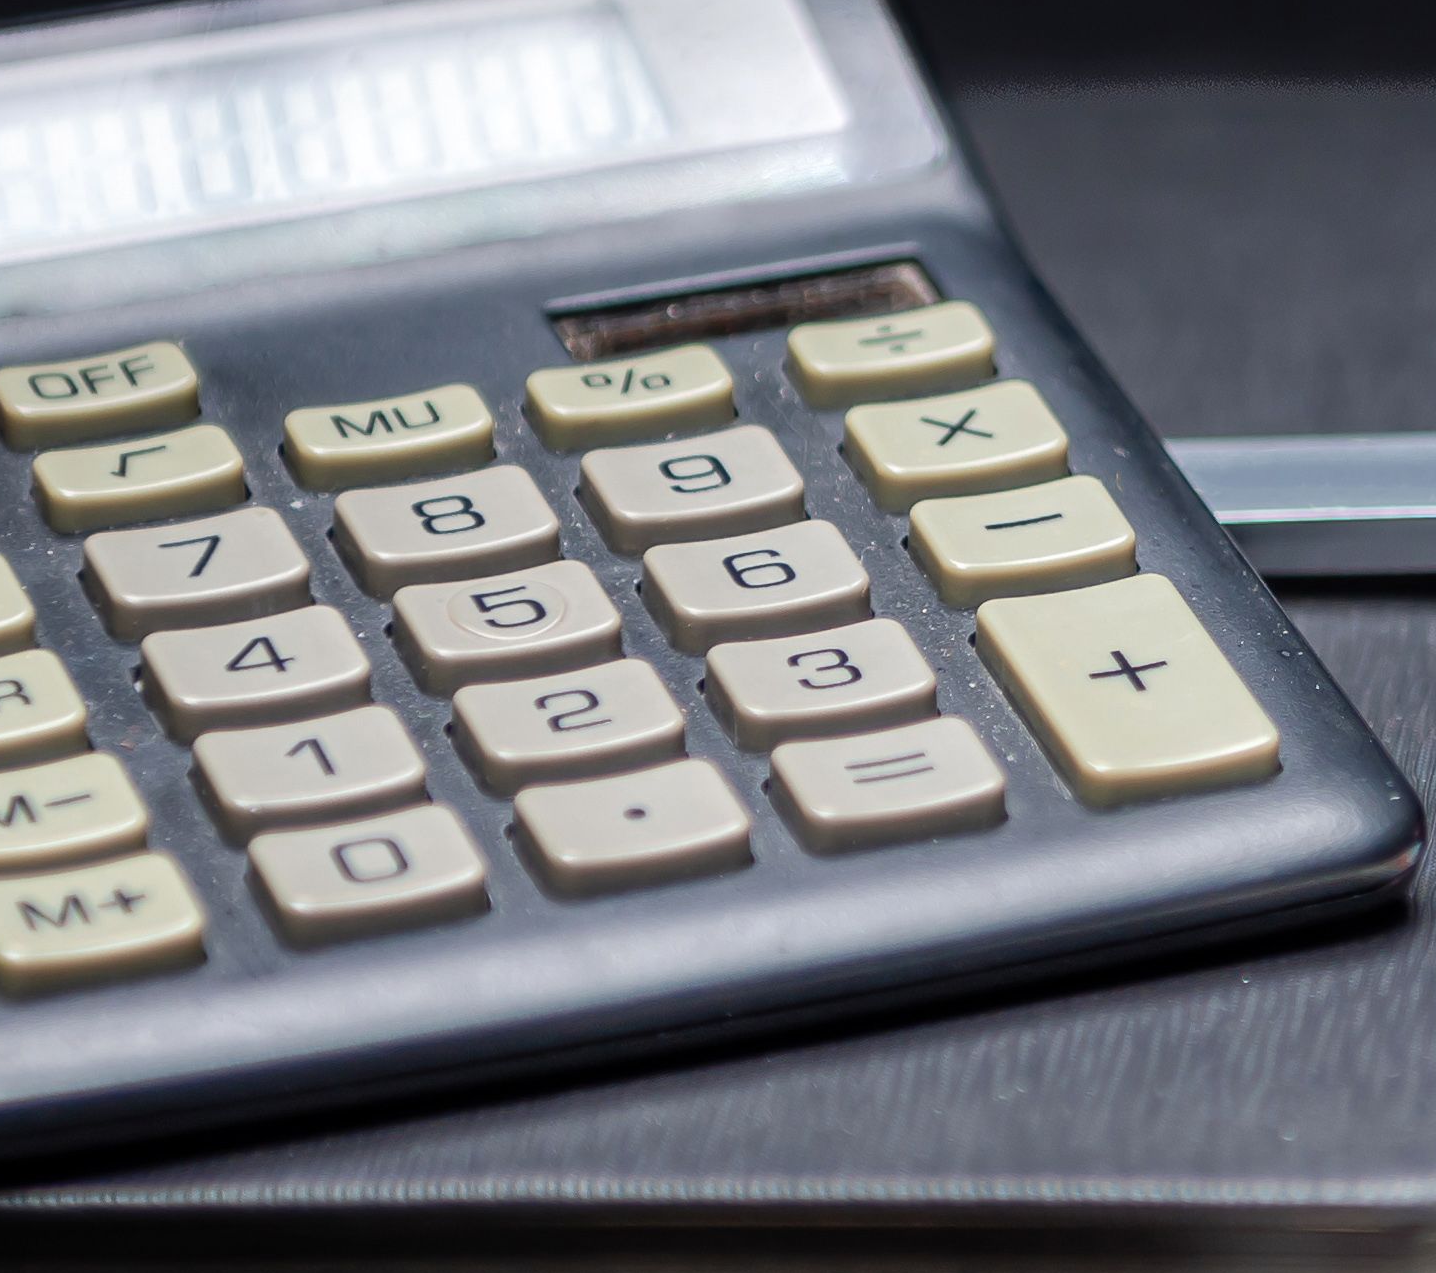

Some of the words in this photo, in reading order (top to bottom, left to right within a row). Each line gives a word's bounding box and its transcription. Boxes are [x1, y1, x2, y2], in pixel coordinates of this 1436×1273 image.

[26, 353, 156, 403] OFF
[329, 400, 442, 440] MU
[657, 453, 733, 495] 9
[409, 493, 487, 537] 8
[158, 533, 222, 580] 7
[722, 547, 797, 591] 6
[470, 585, 548, 630] 5
[223, 635, 298, 676] 4
[786, 647, 862, 691] 3
[533, 689, 614, 734] 2
[282, 735, 339, 778] 1
[329, 835, 410, 886] 0
[16, 885, 148, 935] M+
